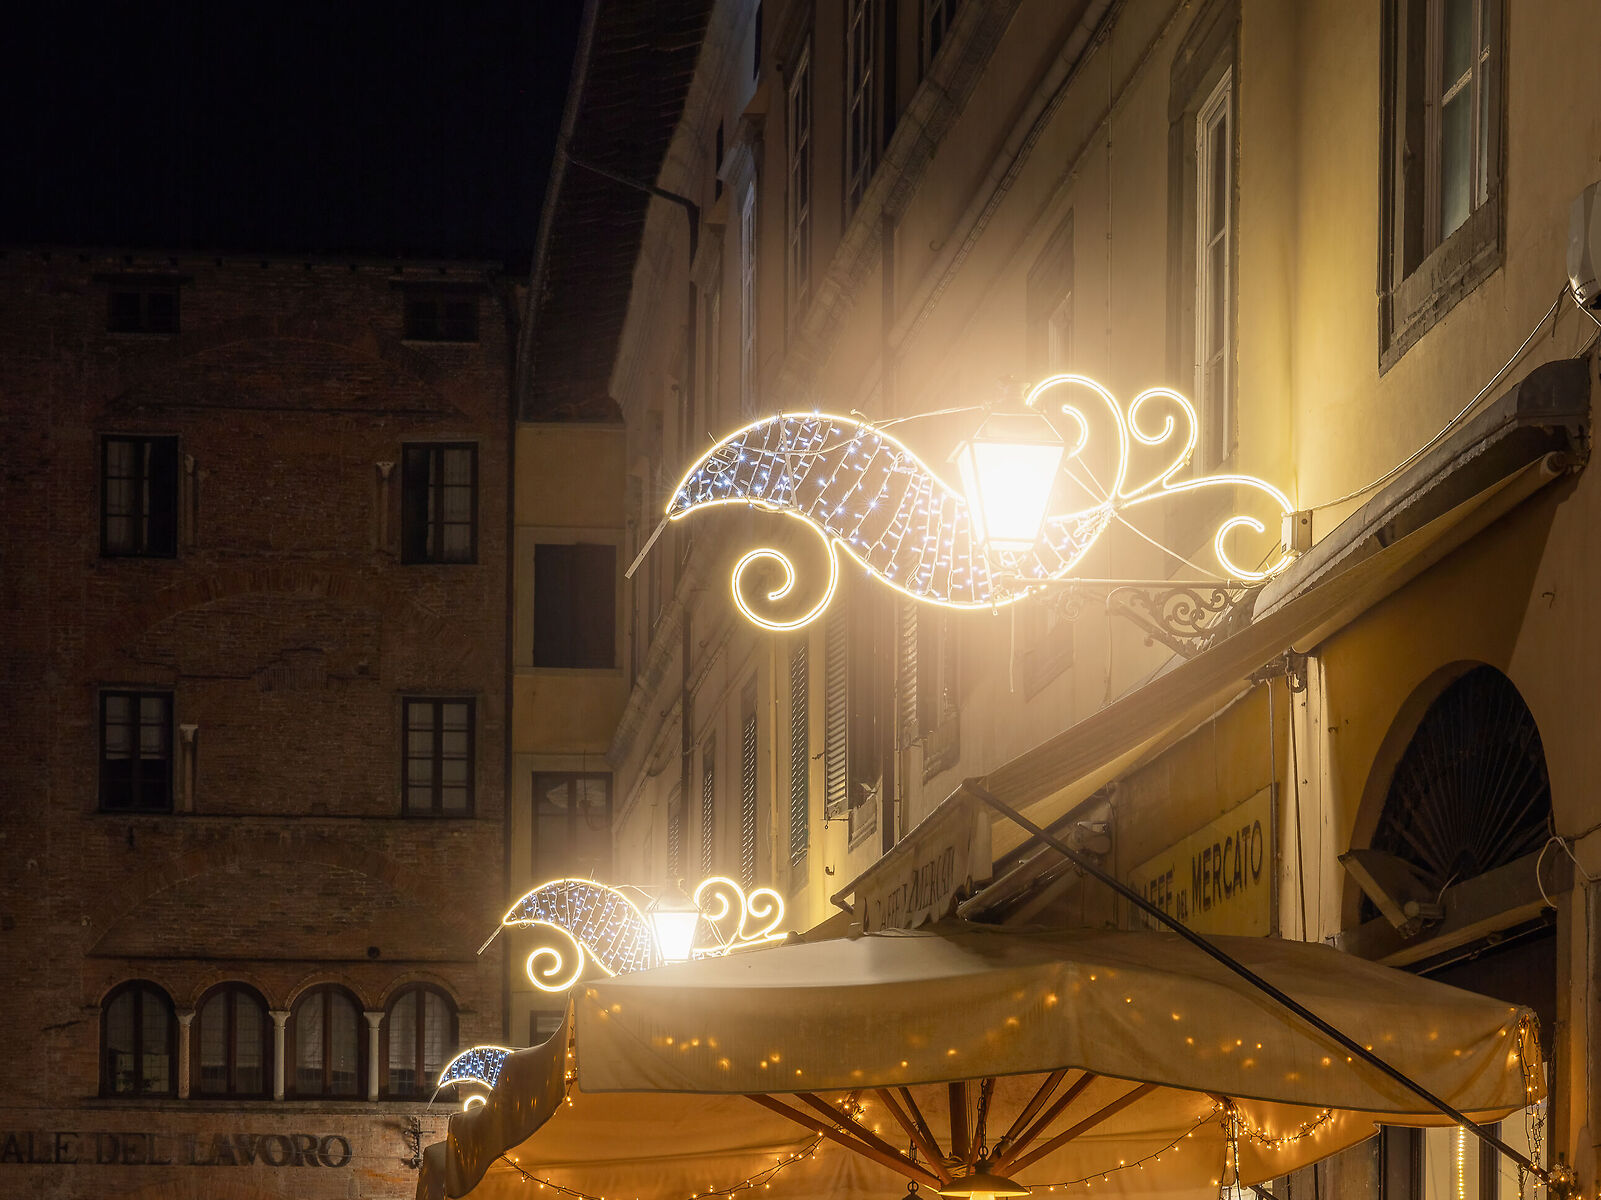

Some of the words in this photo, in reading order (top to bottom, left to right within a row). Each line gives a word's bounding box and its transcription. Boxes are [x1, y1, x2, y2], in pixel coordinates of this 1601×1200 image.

[1191, 819, 1263, 914] MERCATO
[94, 1132, 172, 1165] DEL
[186, 1133, 353, 1168] LAVORO
